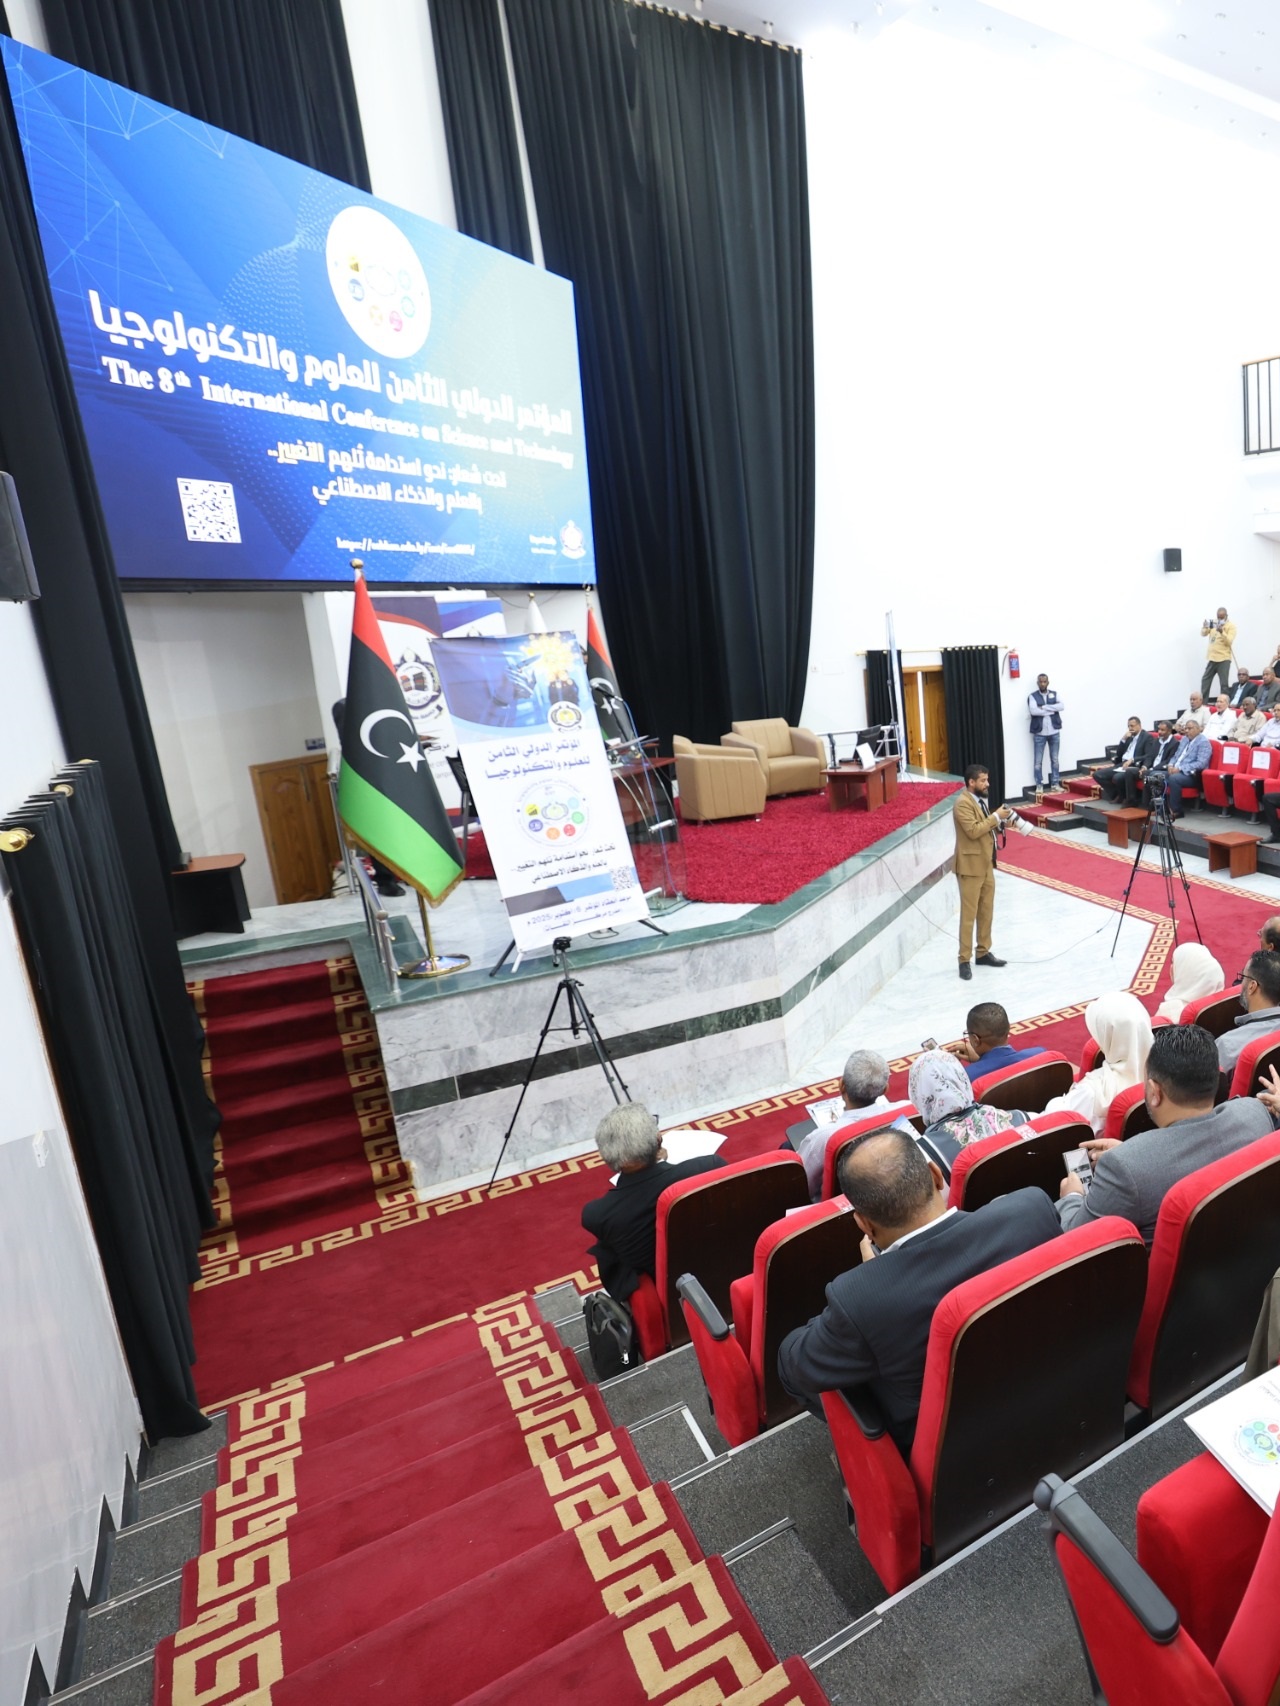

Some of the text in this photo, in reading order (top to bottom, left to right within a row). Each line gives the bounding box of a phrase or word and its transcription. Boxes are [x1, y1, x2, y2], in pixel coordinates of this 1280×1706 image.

[88, 289, 299, 383] والتكنولوجيا
[303, 352, 382, 394] للعلوم
[101, 355, 154, 390] The
[157, 366, 192, 394] 8th
[199, 375, 330, 422] International
[331, 401, 420, 438] Conference
[421, 425, 440, 443] on
[385, 371, 449, 408] الثامن
[451, 386, 515, 424] الدولي
[366, 451, 422, 477] استدامة
[312, 476, 392, 506] الاصطناعي
[394, 484, 445, 512] والذكاء
[487, 745, 519, 762] الثامن
[522, 742, 552, 758] الدولي
[485, 755, 591, 780] للعلوم والتكنولوجيا
